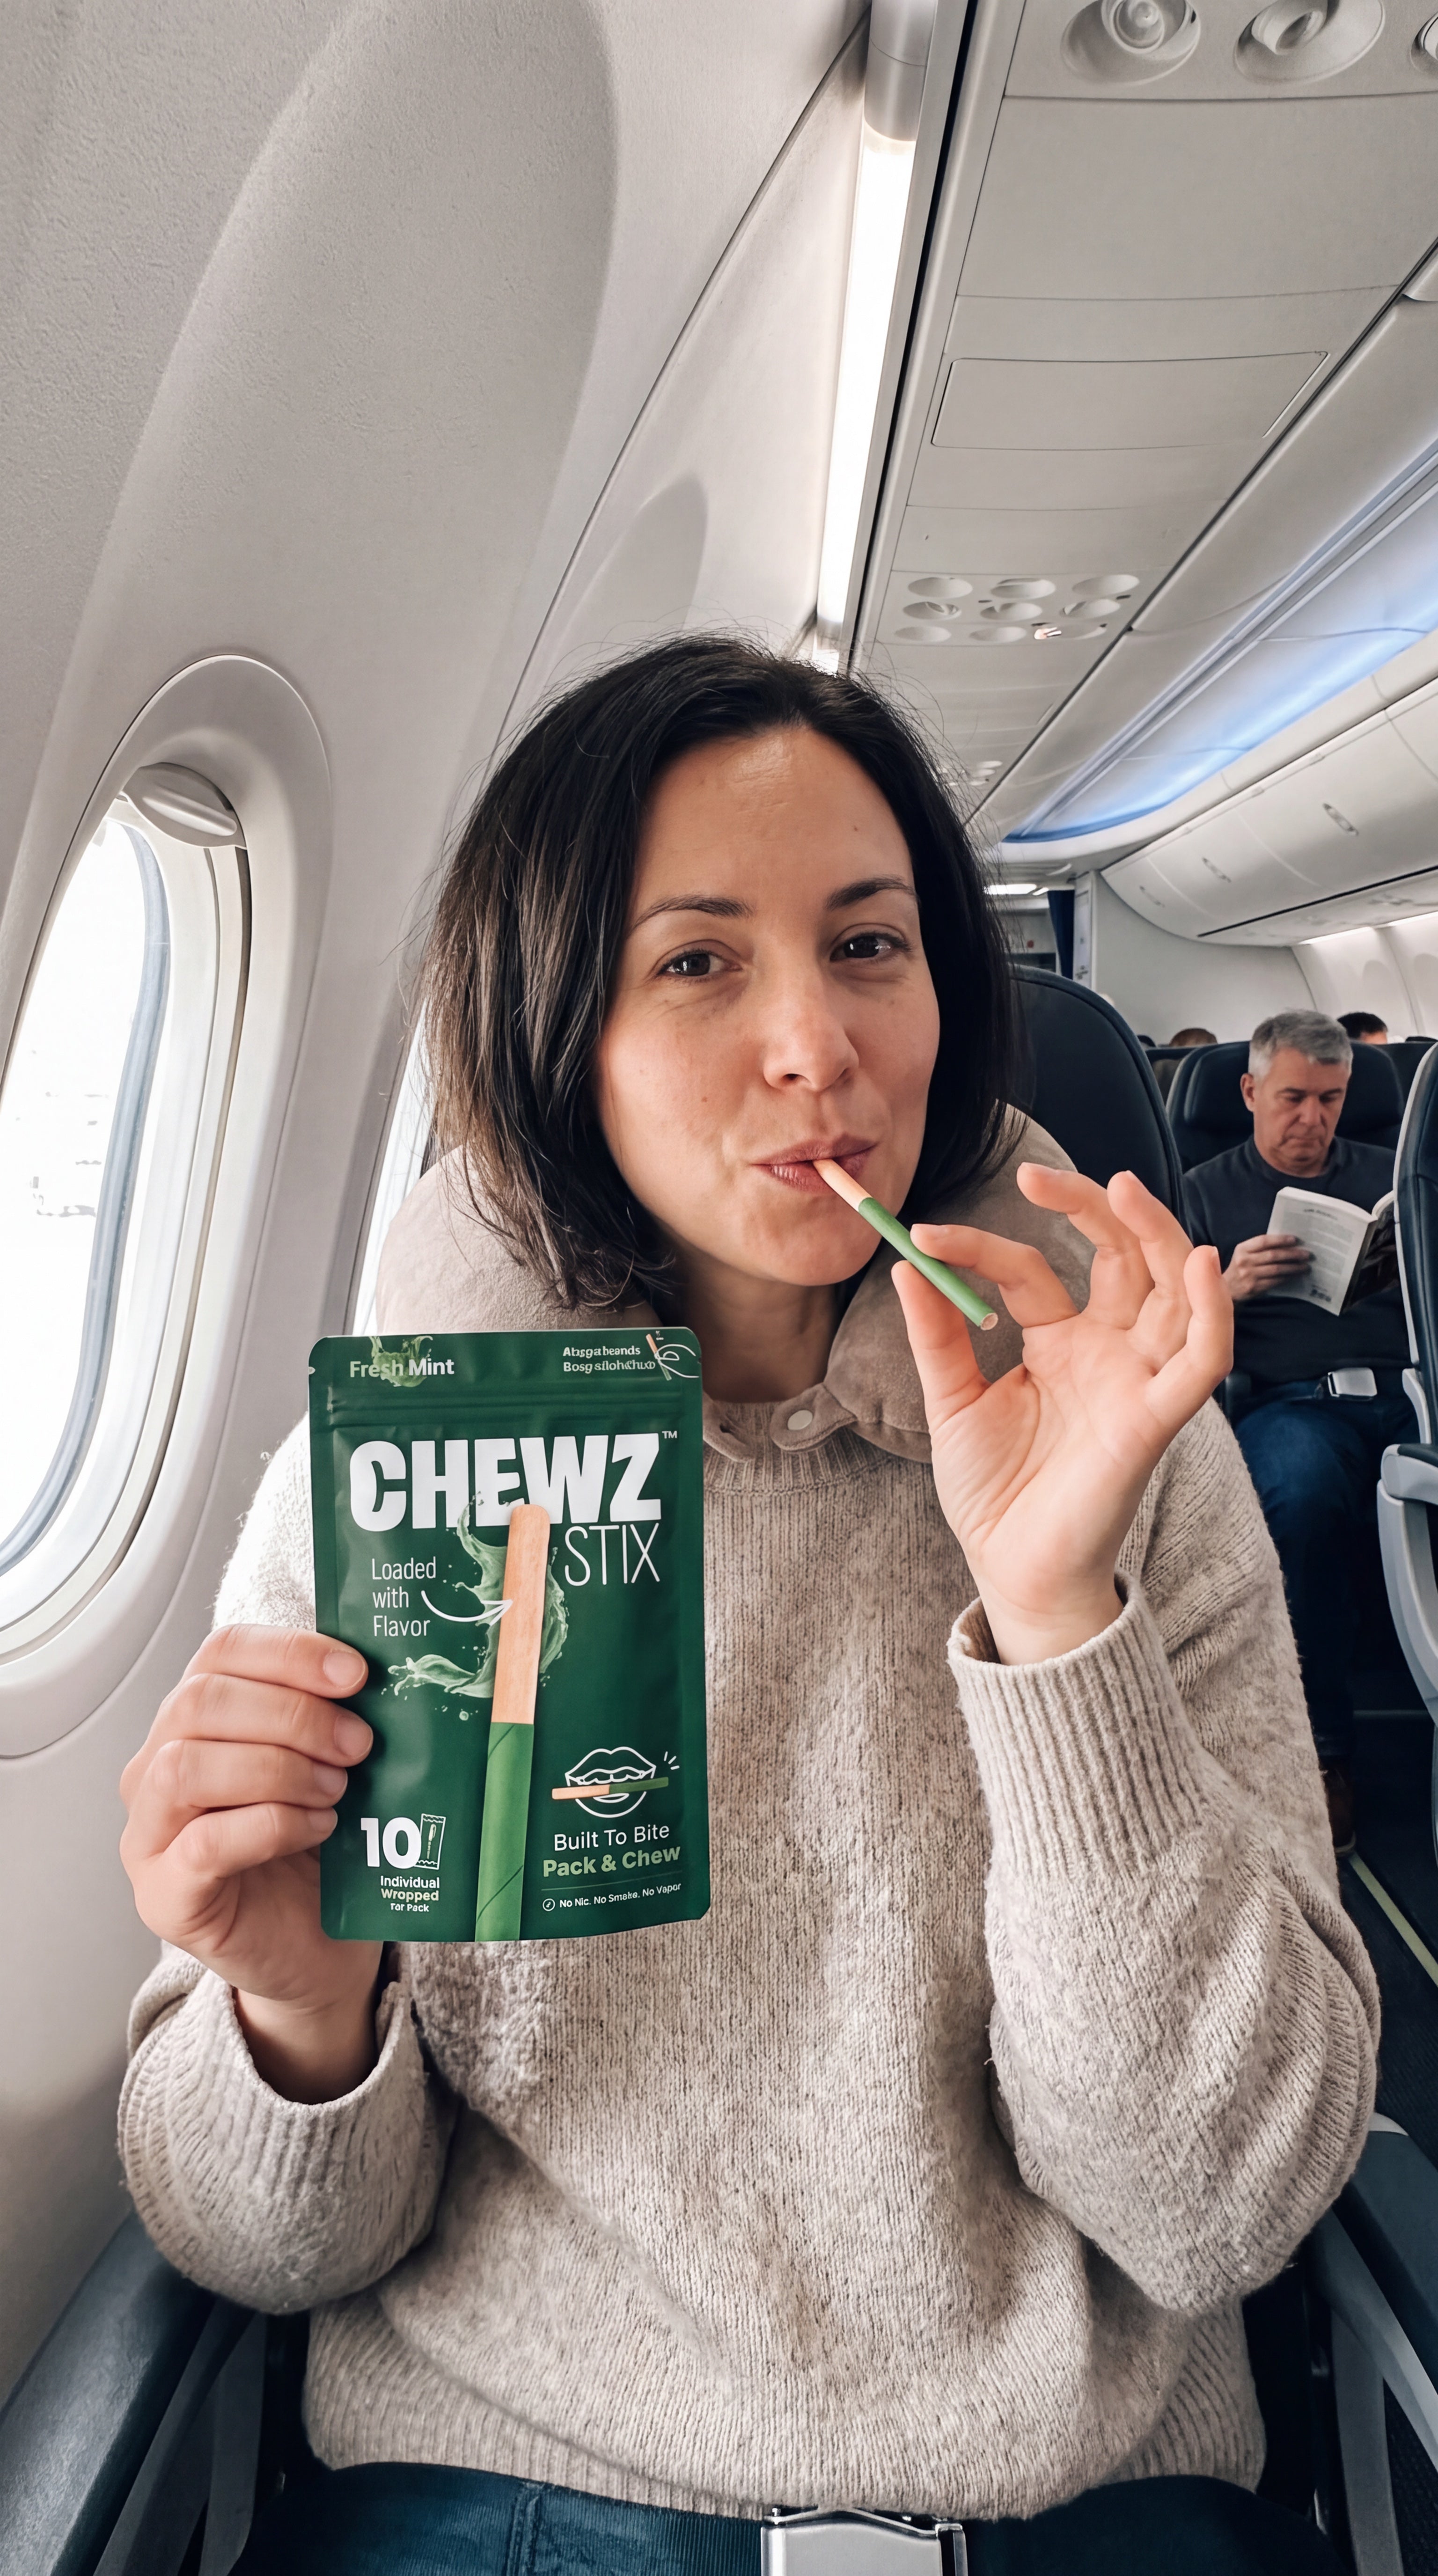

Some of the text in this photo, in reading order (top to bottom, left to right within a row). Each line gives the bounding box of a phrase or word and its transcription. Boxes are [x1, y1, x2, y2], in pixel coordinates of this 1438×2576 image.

[350, 1358, 455, 1378] Fresh Mint
[350, 1433, 661, 1532] CHEWZ
[565, 1522, 660, 1587] STIX
[372, 1556, 436, 1580] Loaded
[372, 1586, 409, 1609] with
[374, 1615, 431, 1637] Flavor
[360, 1817, 422, 1869] 10
[554, 1824, 670, 1852] Built To Bite
[543, 1846, 681, 1877] Pack & Chew
[380, 1875, 440, 1888] Individual
[407, 1903, 430, 1912] Pack
[559, 1899, 573, 1908] No
[574, 1897, 591, 1907] Nic.
[594, 1895, 607, 1905] No
[642, 1888, 655, 1897] No
[656, 1883, 682, 1895] Vapor
